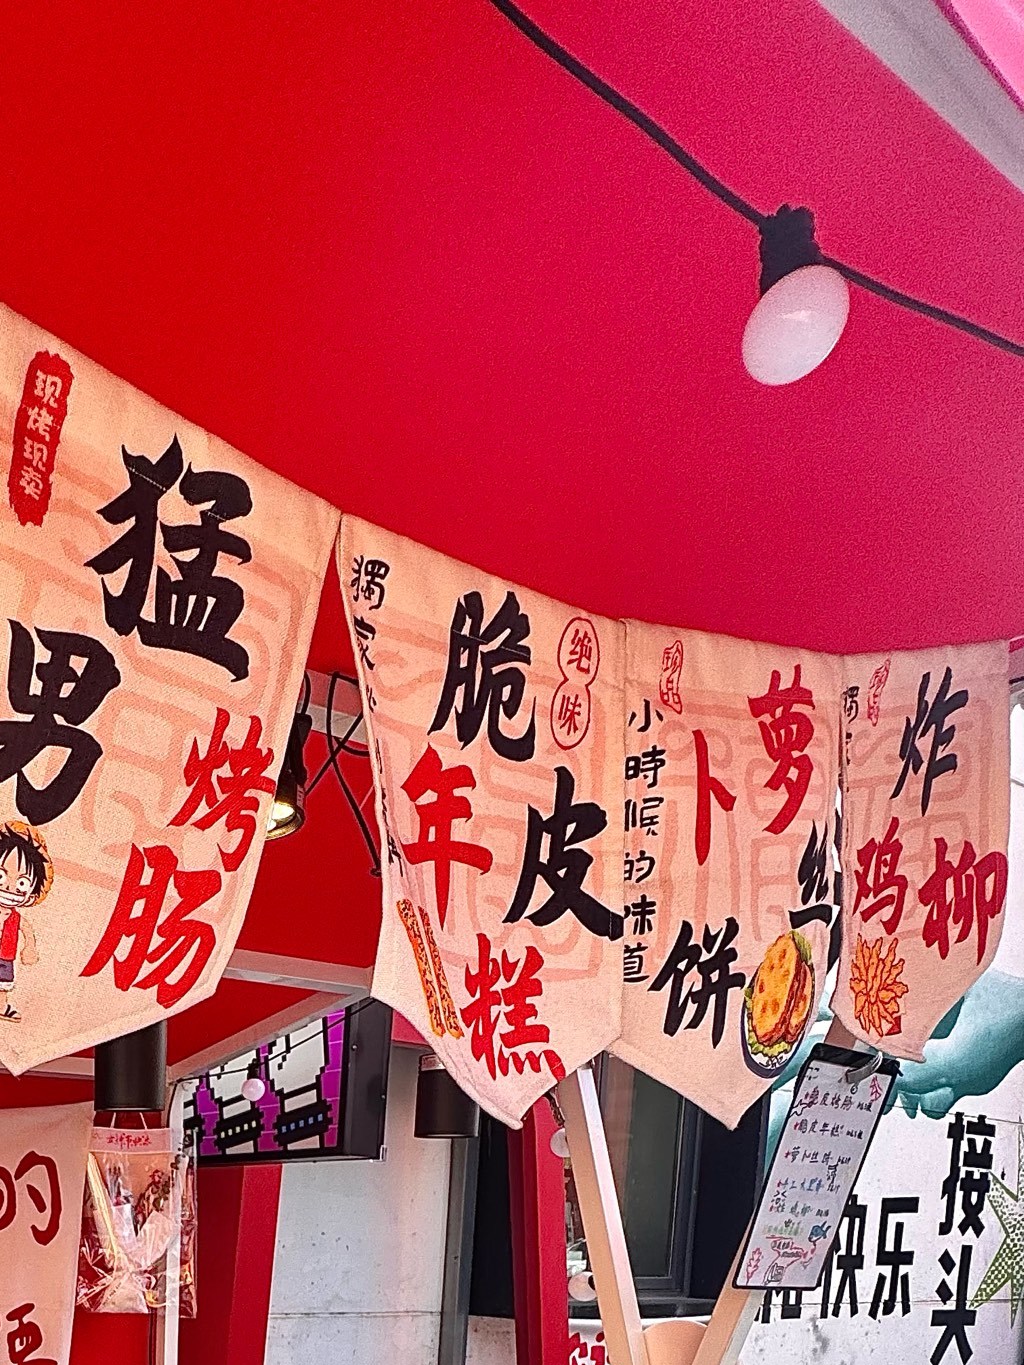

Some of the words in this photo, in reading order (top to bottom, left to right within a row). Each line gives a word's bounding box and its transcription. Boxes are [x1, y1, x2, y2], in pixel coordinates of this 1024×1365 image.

[19, 368, 63, 501] 现烤现卖
[79, 706, 277, 1010] 烤肠
